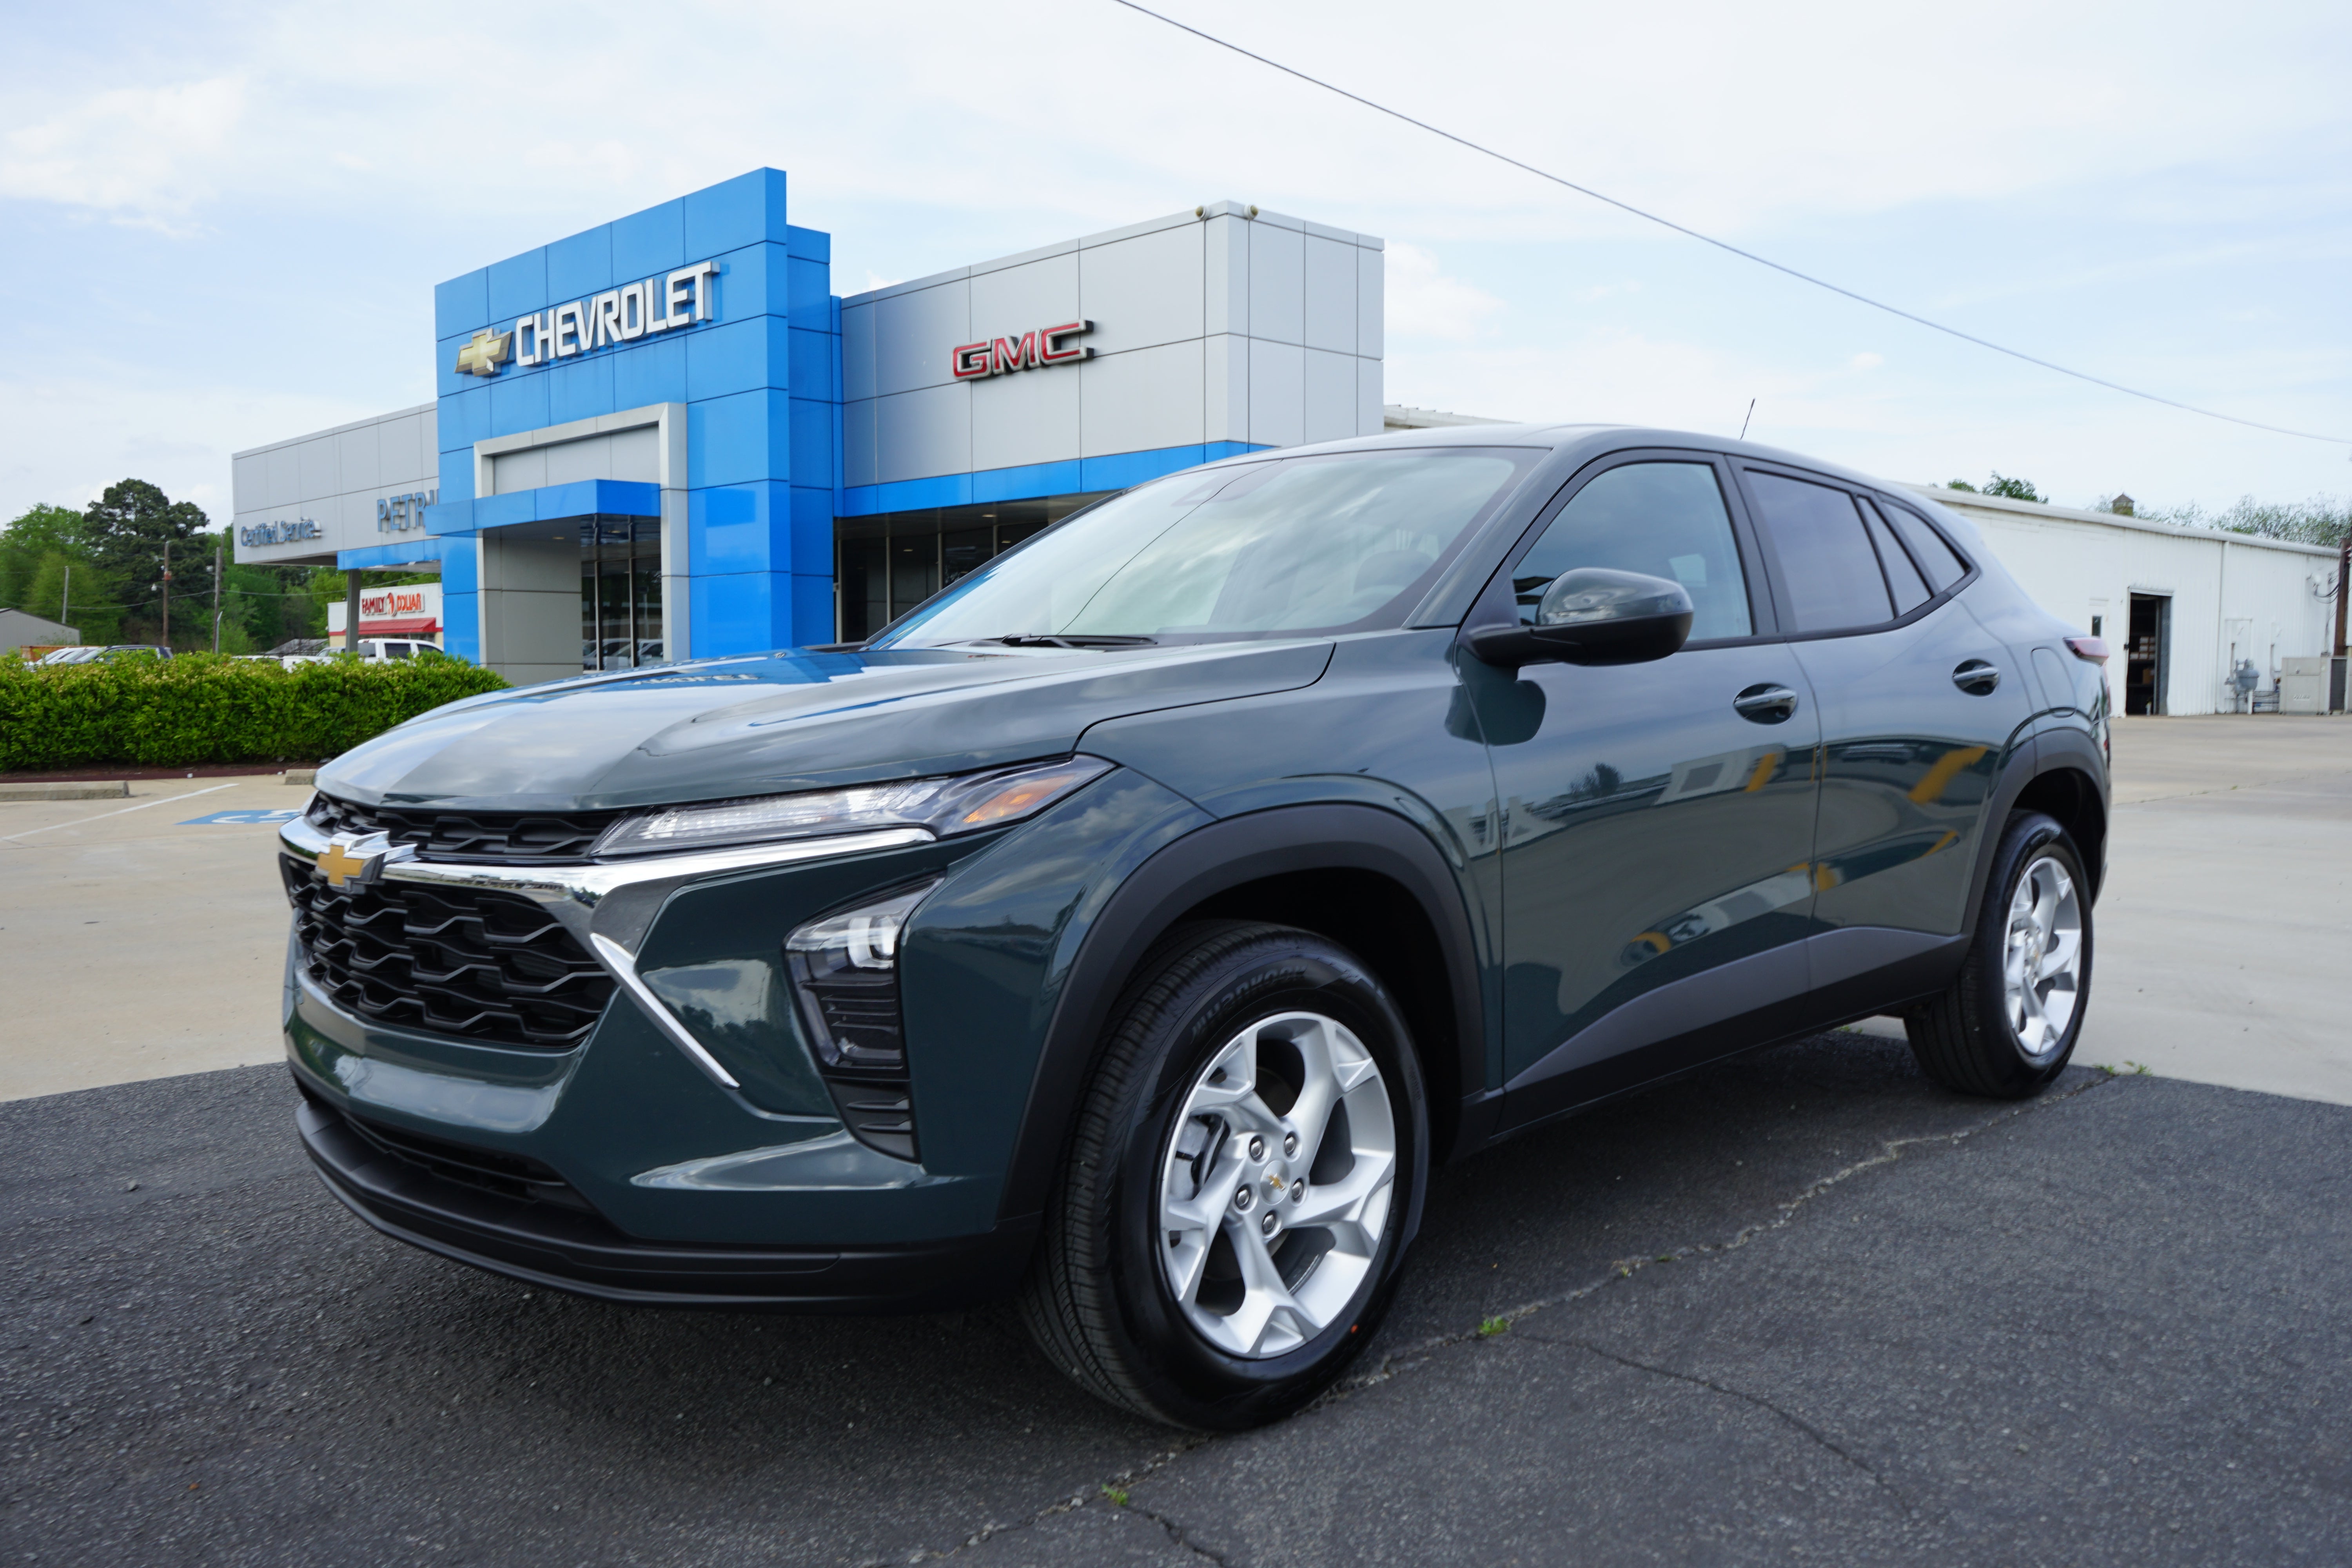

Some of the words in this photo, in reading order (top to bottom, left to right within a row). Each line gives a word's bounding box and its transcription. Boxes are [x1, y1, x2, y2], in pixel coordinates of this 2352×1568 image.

[515, 261, 719, 367] CHEVROLET
[951, 319, 1094, 380] GMC
[241, 521, 278, 547] Certified
[280, 516, 316, 542] Service
[362, 595, 385, 614] FAMILY
[397, 592, 422, 612] DOLLAR
